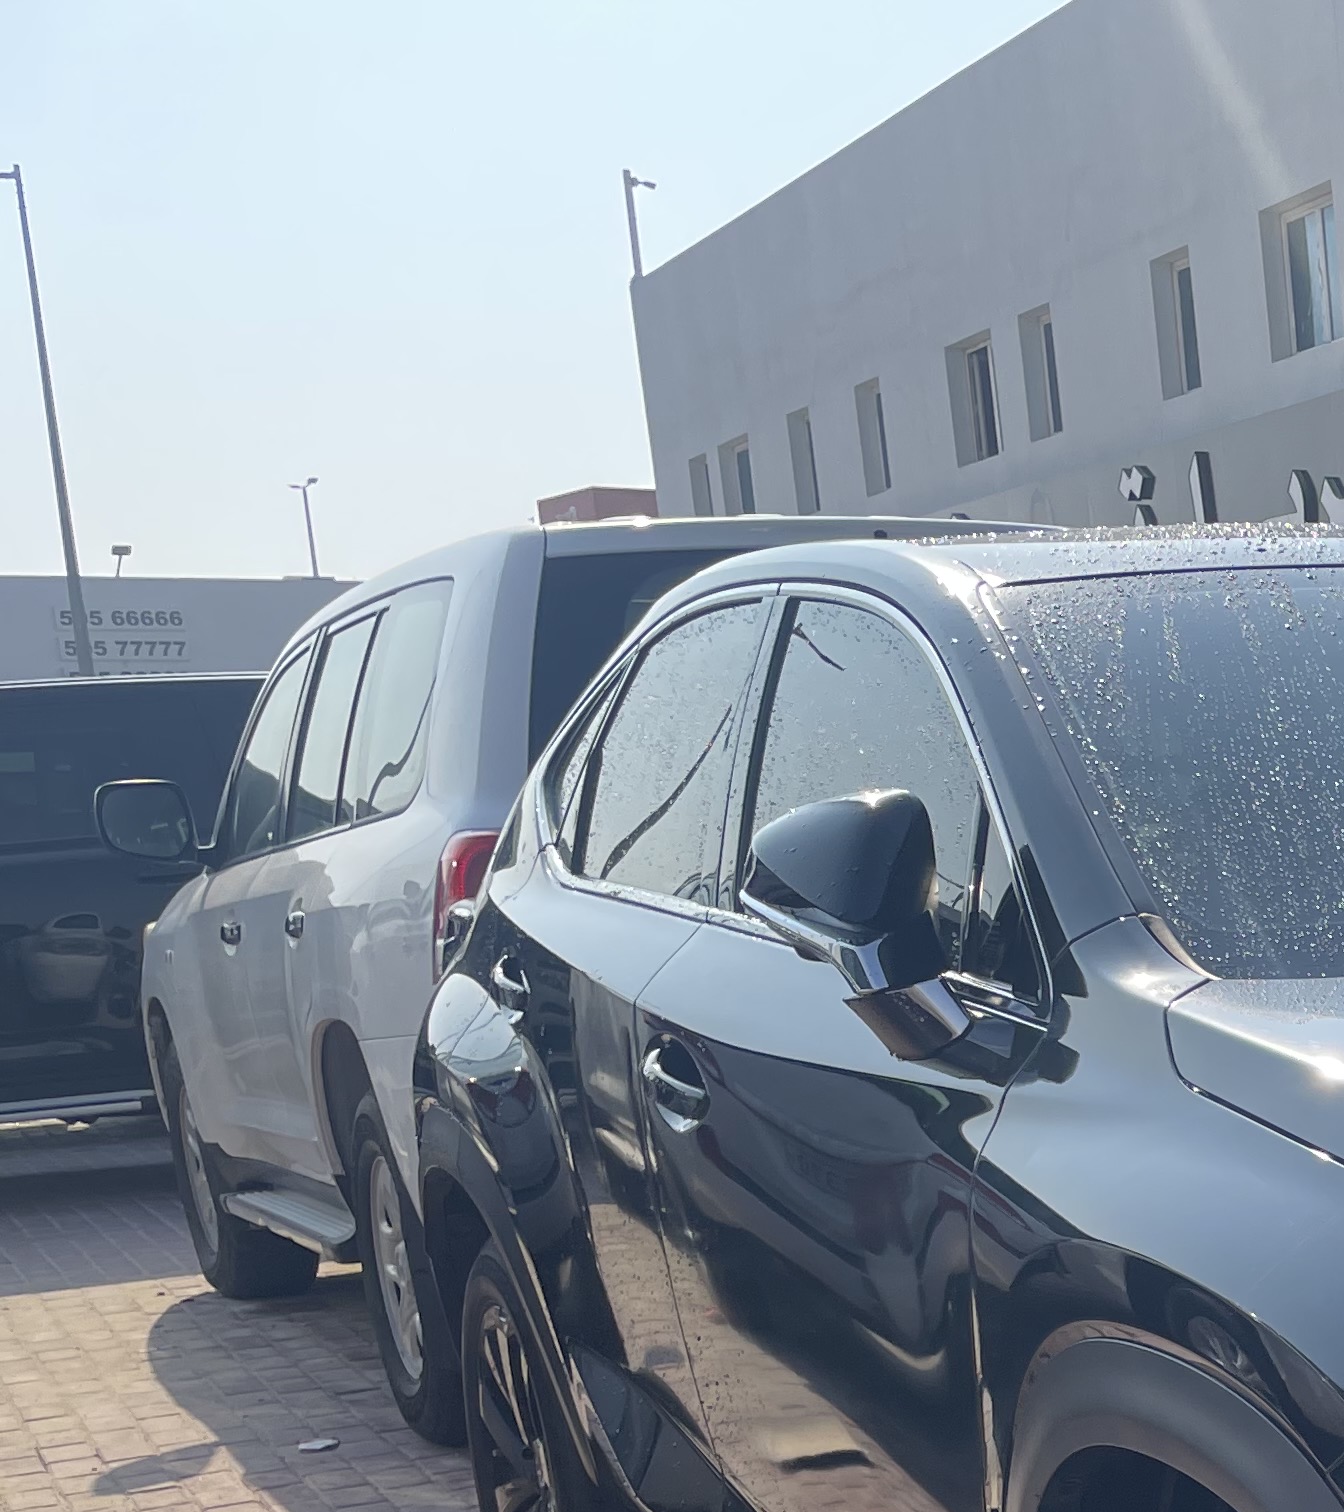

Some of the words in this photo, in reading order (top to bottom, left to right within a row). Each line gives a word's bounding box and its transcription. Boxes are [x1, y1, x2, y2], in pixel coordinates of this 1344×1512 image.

[59, 610, 103, 626] 55
[111, 610, 183, 626] 66666
[64, 640, 107, 657] 55
[115, 640, 186, 656] 77777
